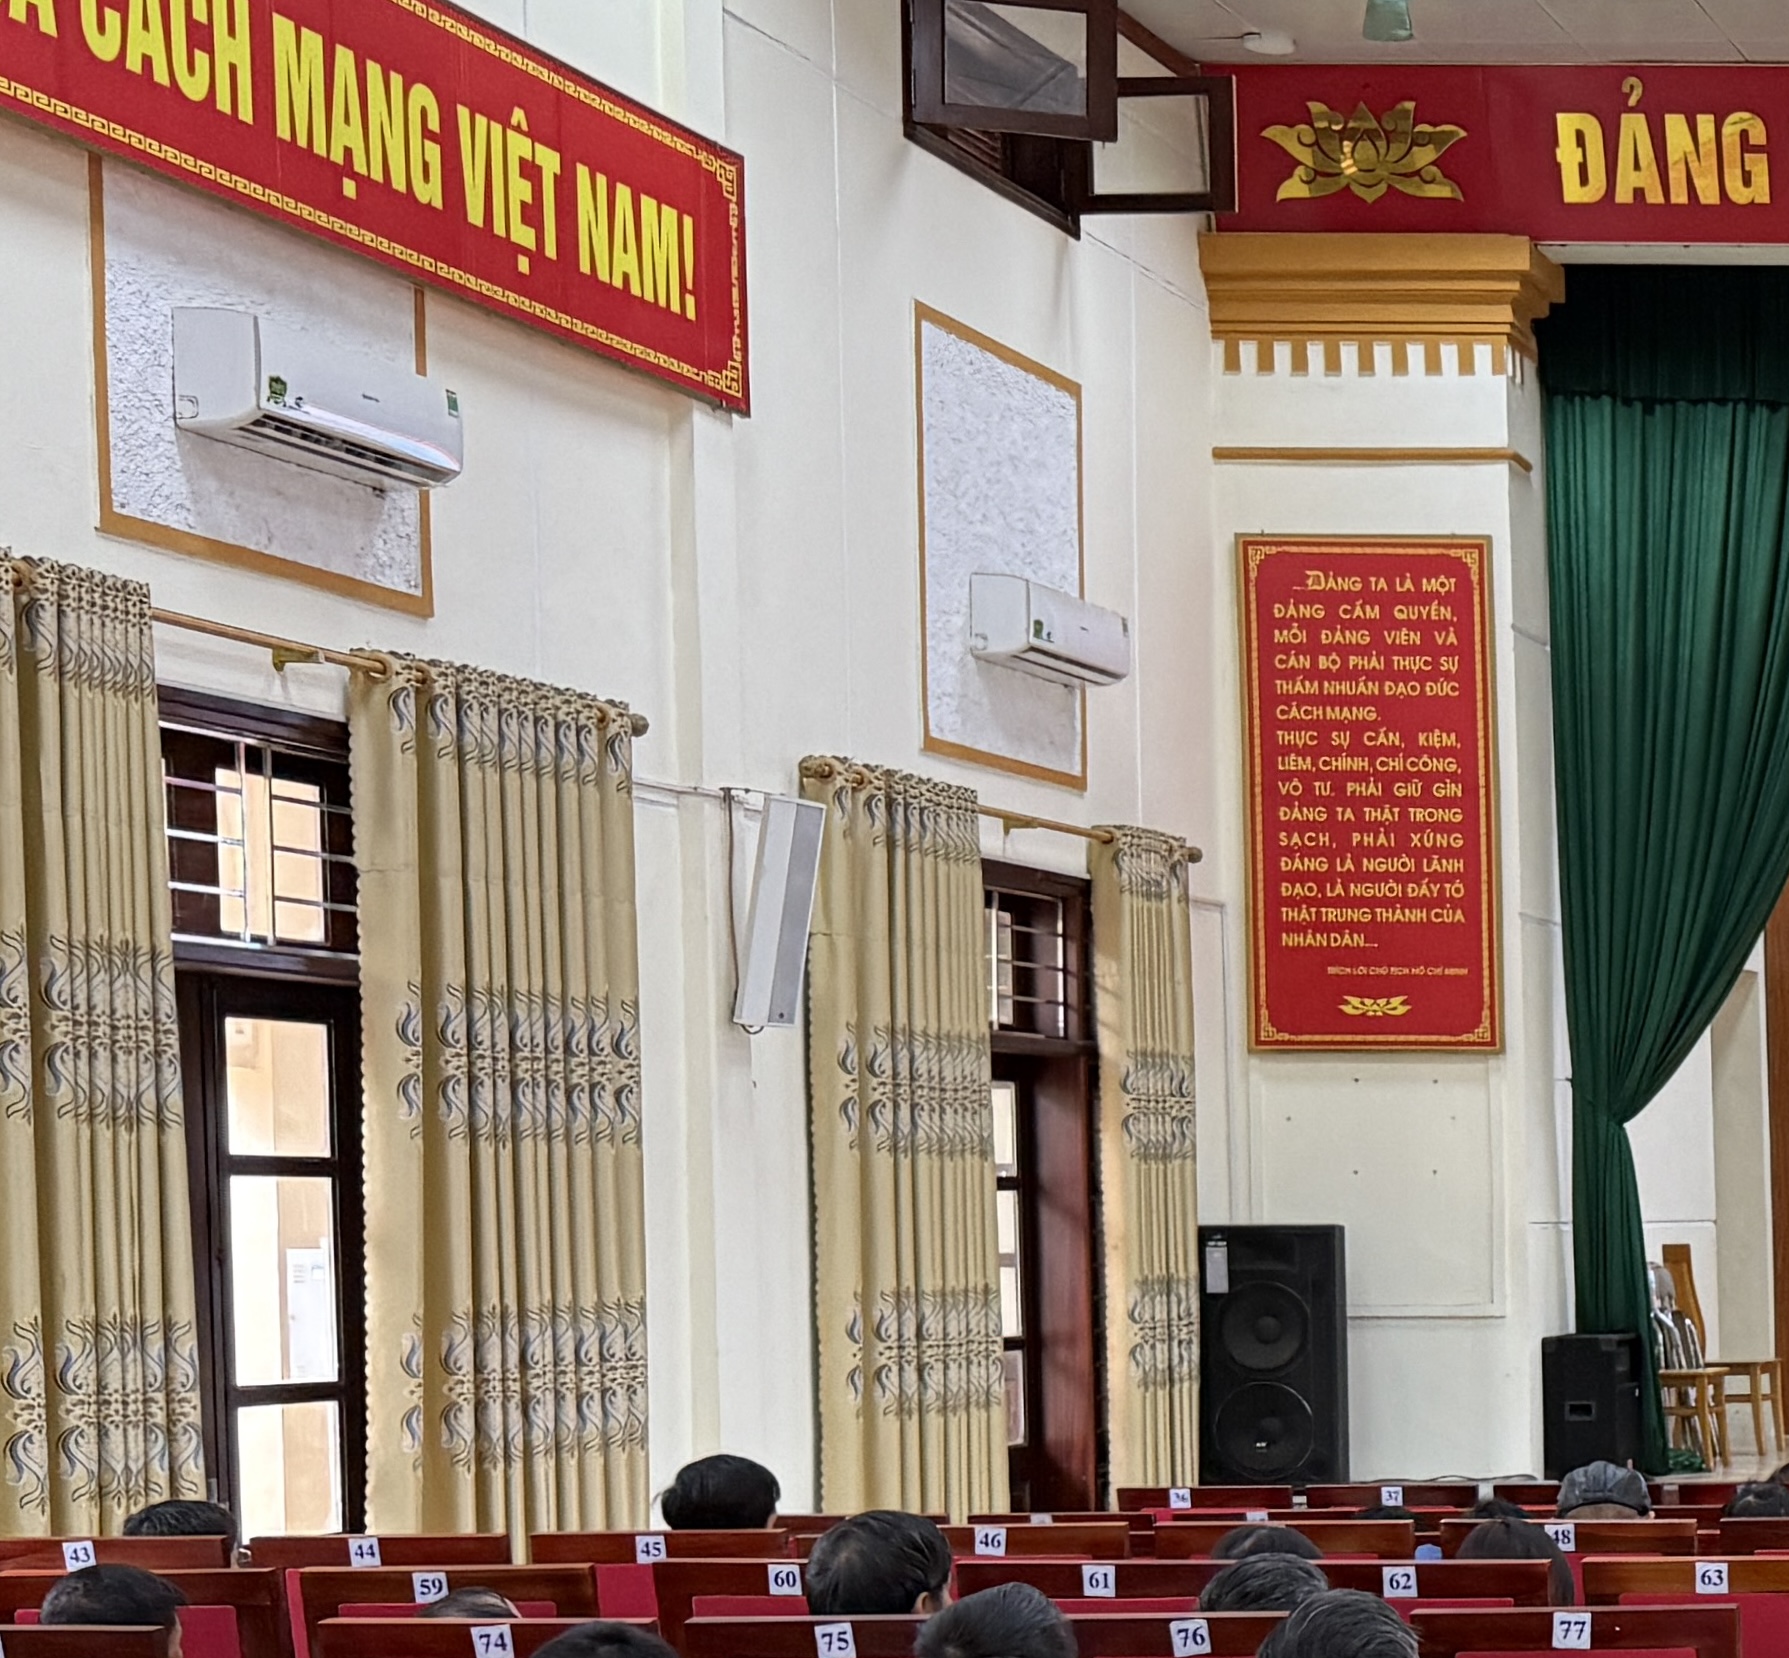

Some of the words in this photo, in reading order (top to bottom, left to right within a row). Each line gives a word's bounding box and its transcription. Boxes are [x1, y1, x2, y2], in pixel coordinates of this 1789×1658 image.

[1555, 76, 1771, 205] ĐẢNG
[272, 11, 444, 211] MẠNG
[456, 105, 561, 276] VIỆT
[575, 161, 697, 322] NAM!
[1369, 577, 1387, 591] TA
[1422, 575, 1456, 595] MỘT
[1274, 599, 1325, 618] ĐẢNG
[1321, 625, 1370, 644] ĐẢNG
[1384, 628, 1420, 645] VIÊN
[1275, 651, 1310, 669] CÁN
[1319, 652, 1341, 672] BỘ
[1349, 651, 1384, 670] PHẢI
[1392, 656, 1431, 673] THỰC
[1440, 656, 1458, 673] SỰ
[1384, 681, 1420, 698] ĐẠO
[1425, 678, 1459, 696] ĐỨC
[1276, 702, 1323, 720] CÁCH
[1277, 731, 1317, 748] THỰC
[1331, 731, 1349, 749] SỰ
[1419, 729, 1460, 748] KIỆM,
[640, 1541, 662, 1557] 45
[979, 1532, 1001, 1548] 46
[69, 1546, 91, 1563] 43
[354, 1543, 376, 1559] 44
[420, 1578, 443, 1596] 59
[773, 1570, 797, 1588] 60
[1088, 1572, 1109, 1589] 61
[1389, 1573, 1412, 1590] 62
[1700, 1569, 1724, 1587] 63
[1177, 1626, 1206, 1648] 76
[1559, 1620, 1587, 1640] 77
[478, 1632, 508, 1654] 74
[821, 1630, 849, 1652] 75
